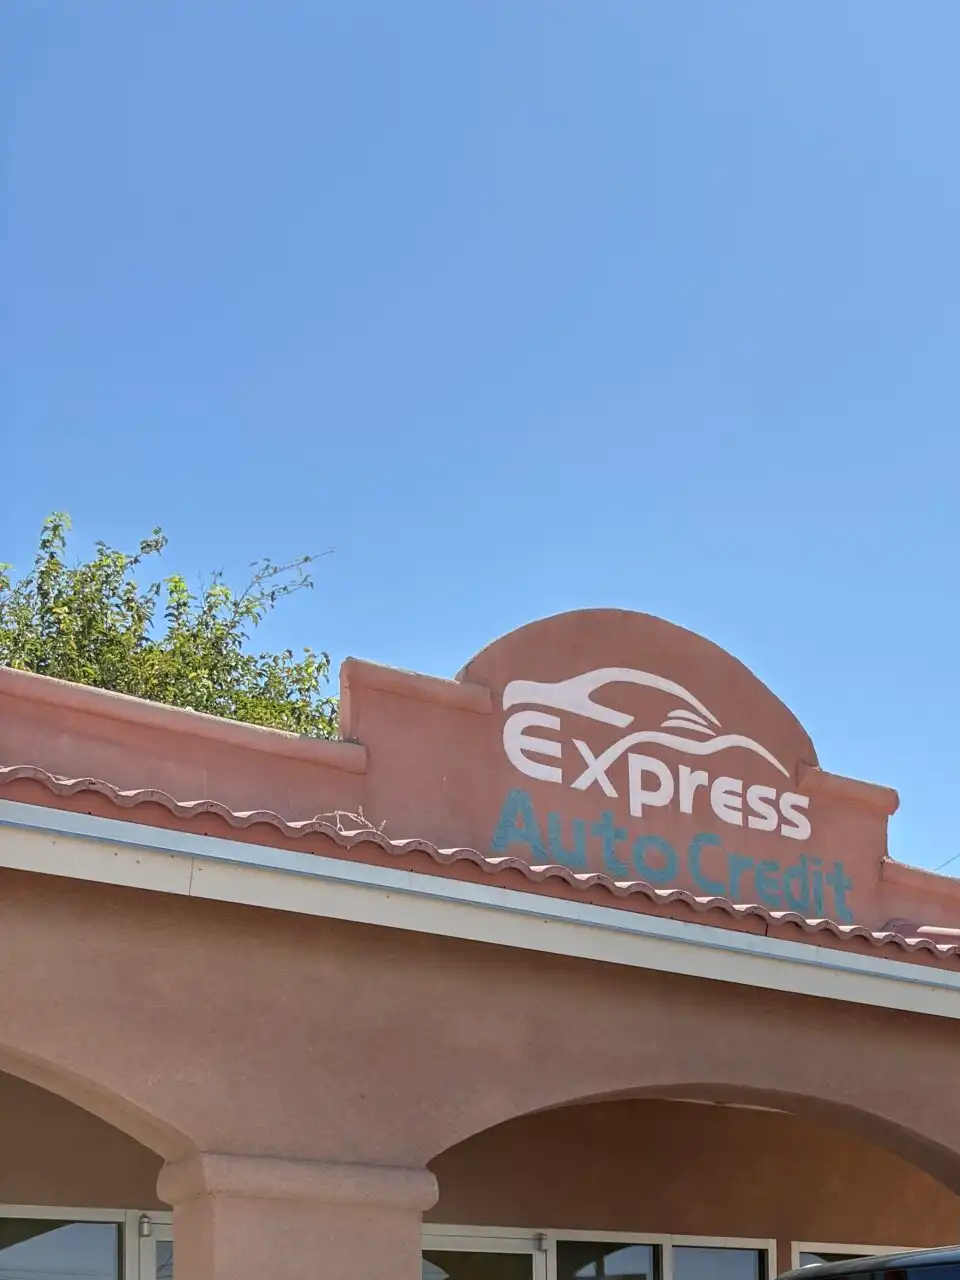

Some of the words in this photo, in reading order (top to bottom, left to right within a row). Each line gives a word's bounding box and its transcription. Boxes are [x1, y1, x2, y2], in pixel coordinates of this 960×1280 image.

[502, 709, 812, 841] Express
[491, 788, 679, 884] Auto
[687, 832, 855, 925] Credit
